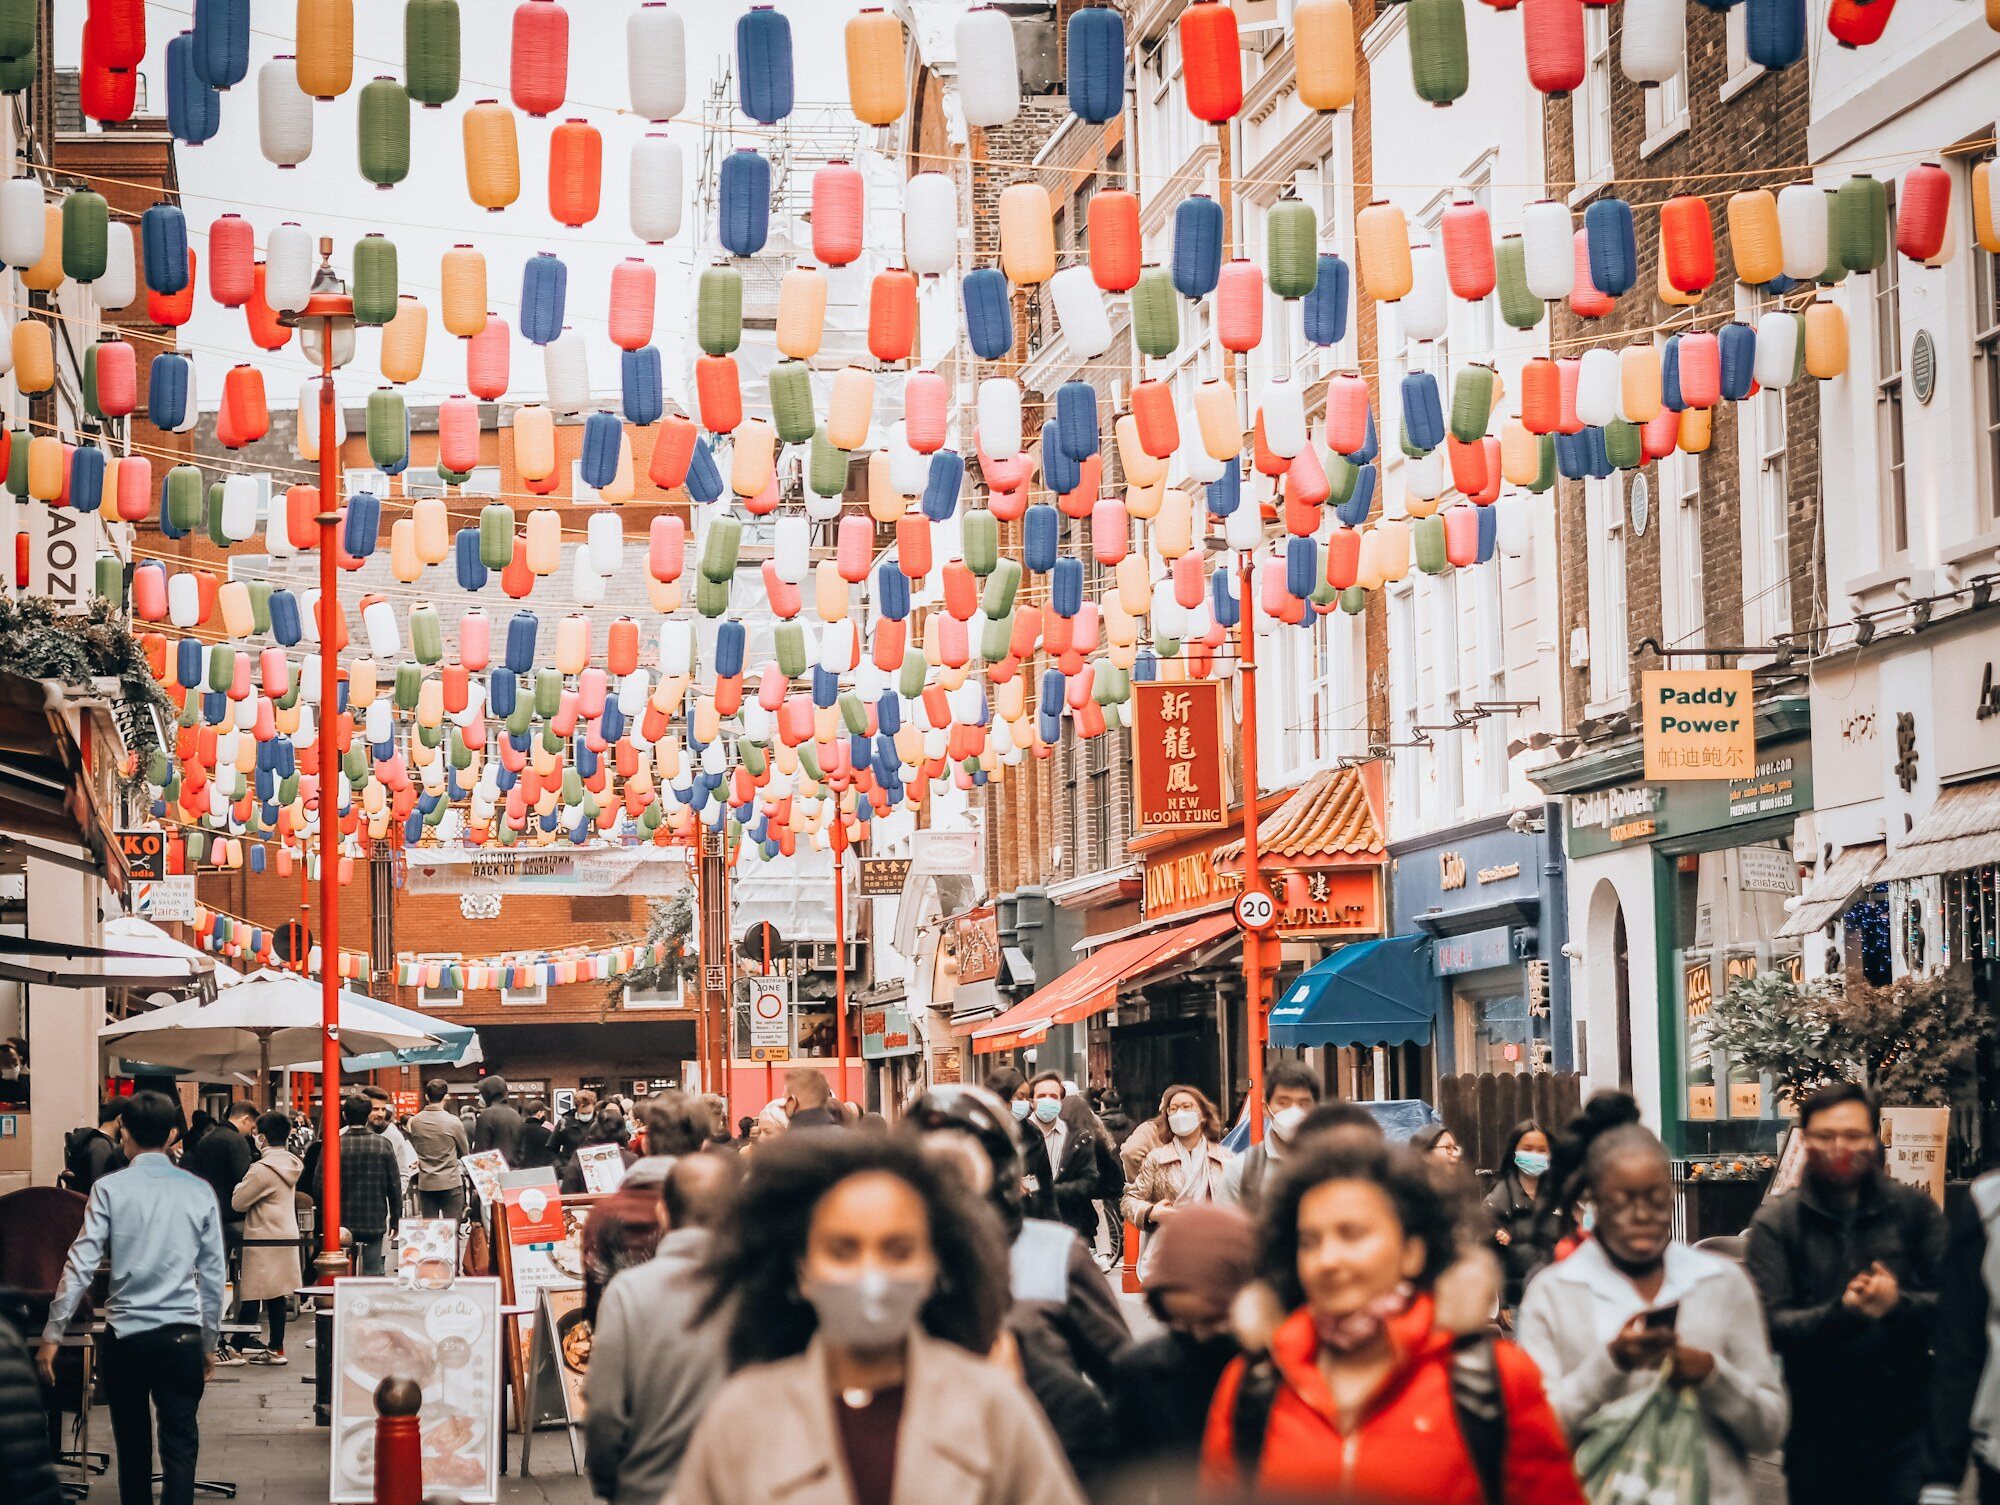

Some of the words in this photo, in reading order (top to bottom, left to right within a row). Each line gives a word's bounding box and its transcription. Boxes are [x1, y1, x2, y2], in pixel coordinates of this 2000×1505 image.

[1659, 687, 1738, 708] Paddy
[1660, 716, 1739, 733] Power
[1160, 690, 1199, 793] 新龍鳳
[1658, 746, 1744, 768] 帕迪鲍尔
[1167, 796, 1200, 810] NEW
[1572, 791, 1609, 829] Paddy
[1608, 787, 1653, 820] Power
[1143, 811, 1181, 824] LOON
[1184, 809, 1220, 822] FUNG
[471, 853, 518, 865] WELCOME
[525, 855, 570, 865] CHINATOWN
[131, 869, 155, 878] udio
[473, 865, 500, 877] BACK
[502, 864, 515, 876] TO
[524, 865, 555, 875] LONDON
[1146, 862, 1175, 910] LOON
[1178, 851, 1209, 901] FUNG
[154, 906, 180, 917] tairs
[1241, 901, 1271, 917] 20
[1277, 905, 1364, 926] AURANT
[1688, 968, 1711, 1002] ACCA
[1924, 1149, 1936, 1162] FREE
